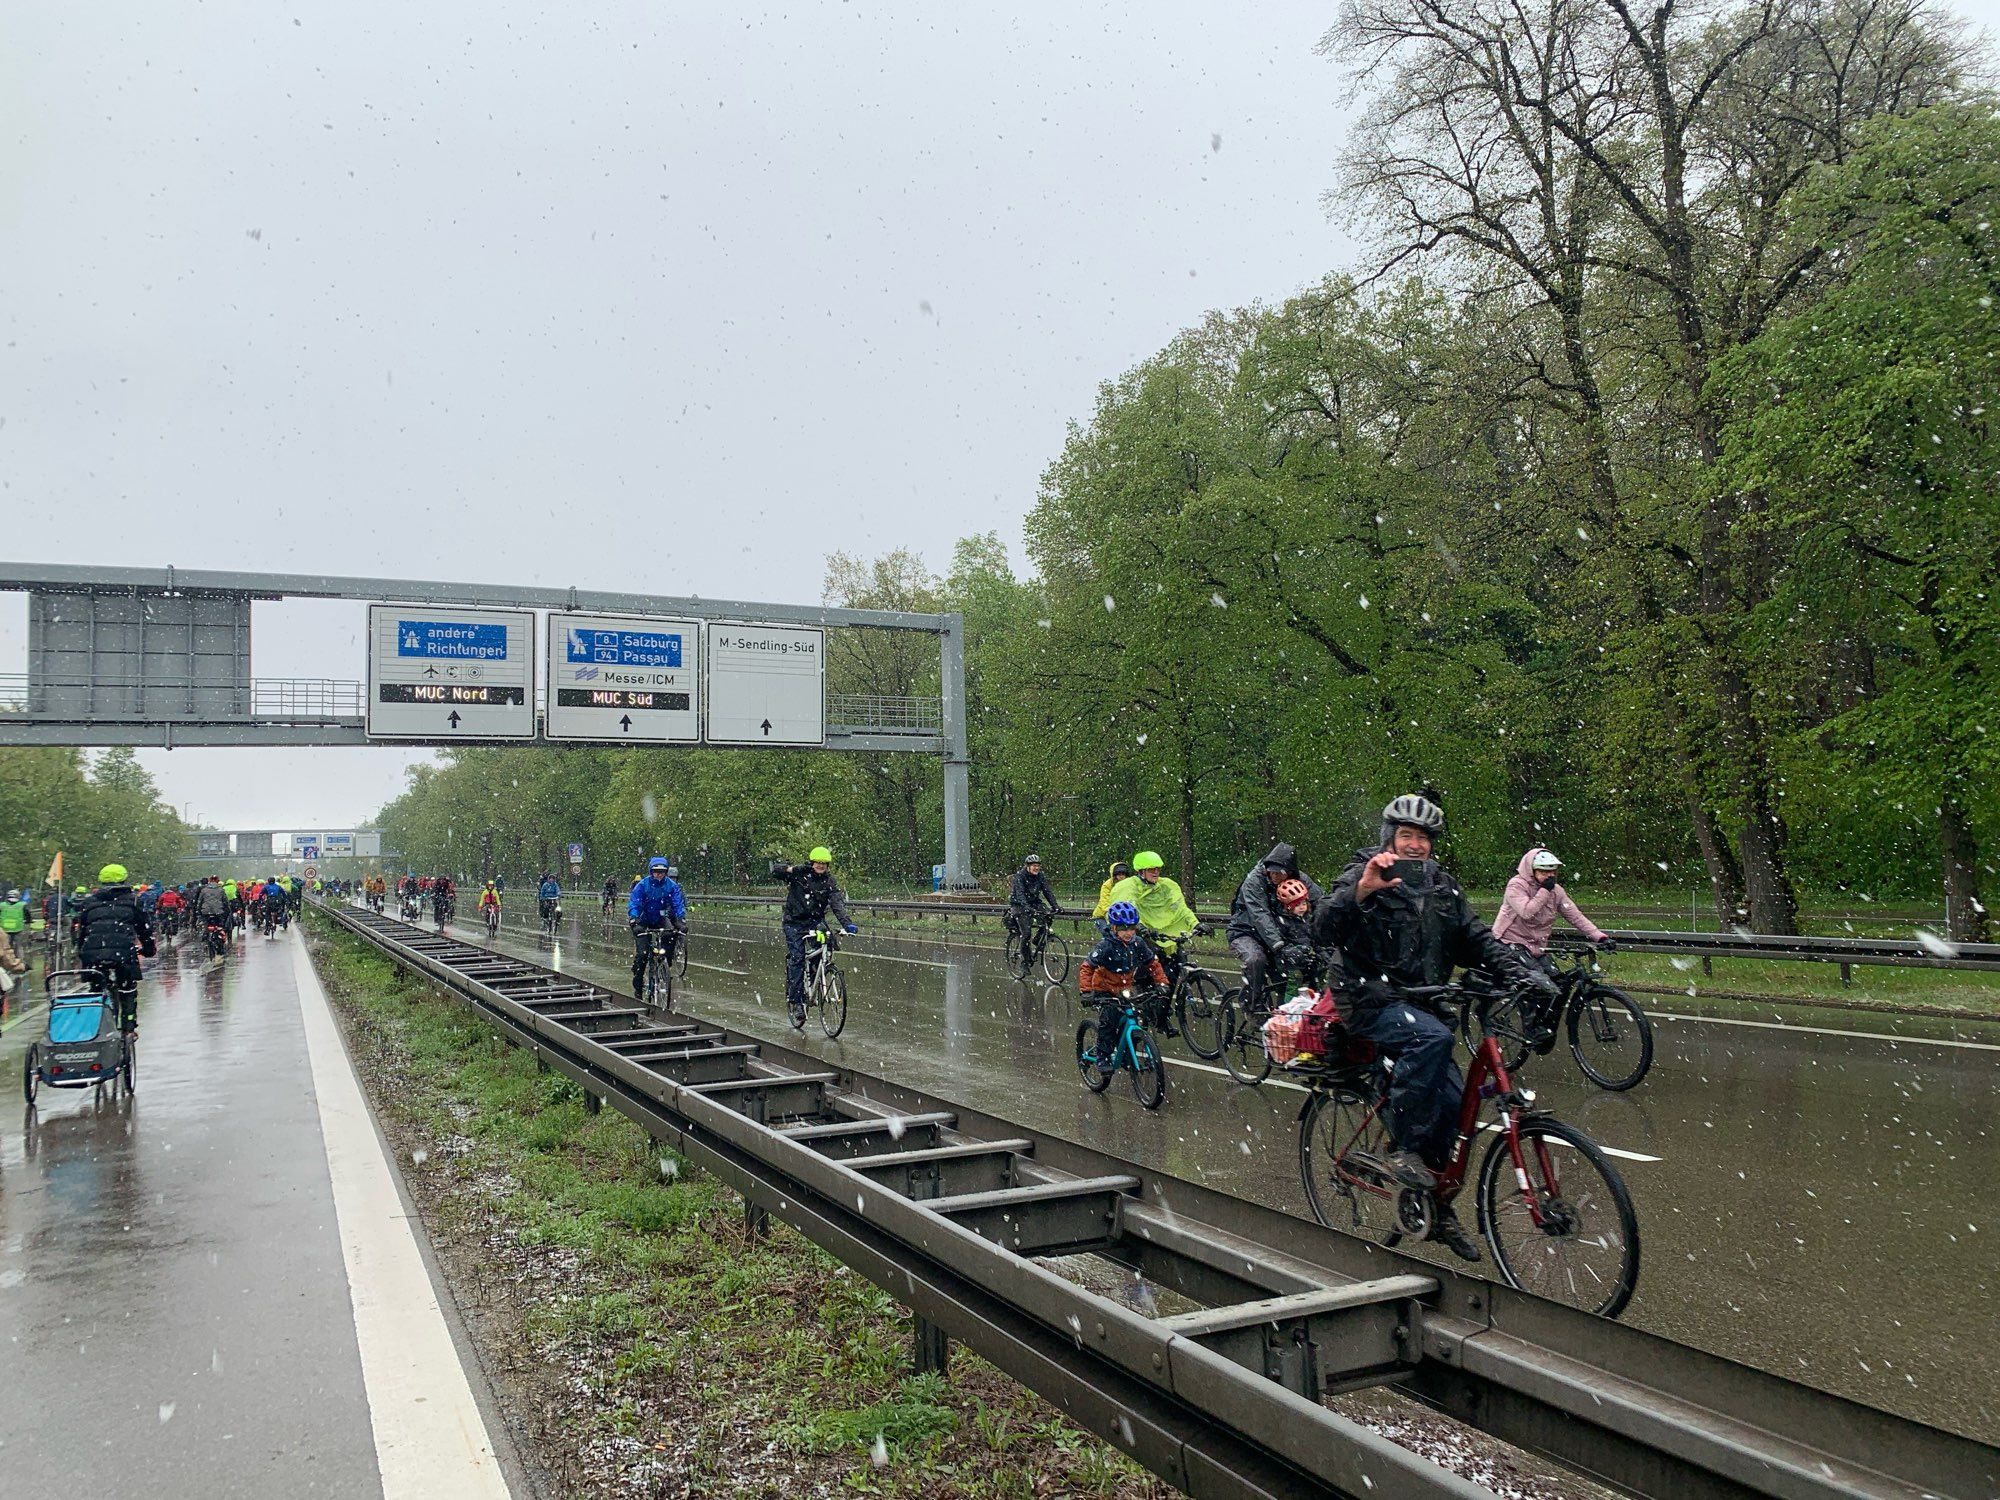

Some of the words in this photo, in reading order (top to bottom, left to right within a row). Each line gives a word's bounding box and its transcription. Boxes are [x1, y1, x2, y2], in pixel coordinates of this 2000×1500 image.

[427, 627, 476, 639] andere
[624, 635, 678, 651] Salzburg
[427, 642, 503, 659] Richtungen
[600, 650, 612, 660] 94
[623, 650, 668, 664] Passau
[604, 672, 675, 686] Messe/ICM
[415, 686, 446, 699] MUC
[452, 687, 488, 700] Nord
[592, 691, 622, 704] MUC
[628, 692, 653, 705] Süd
